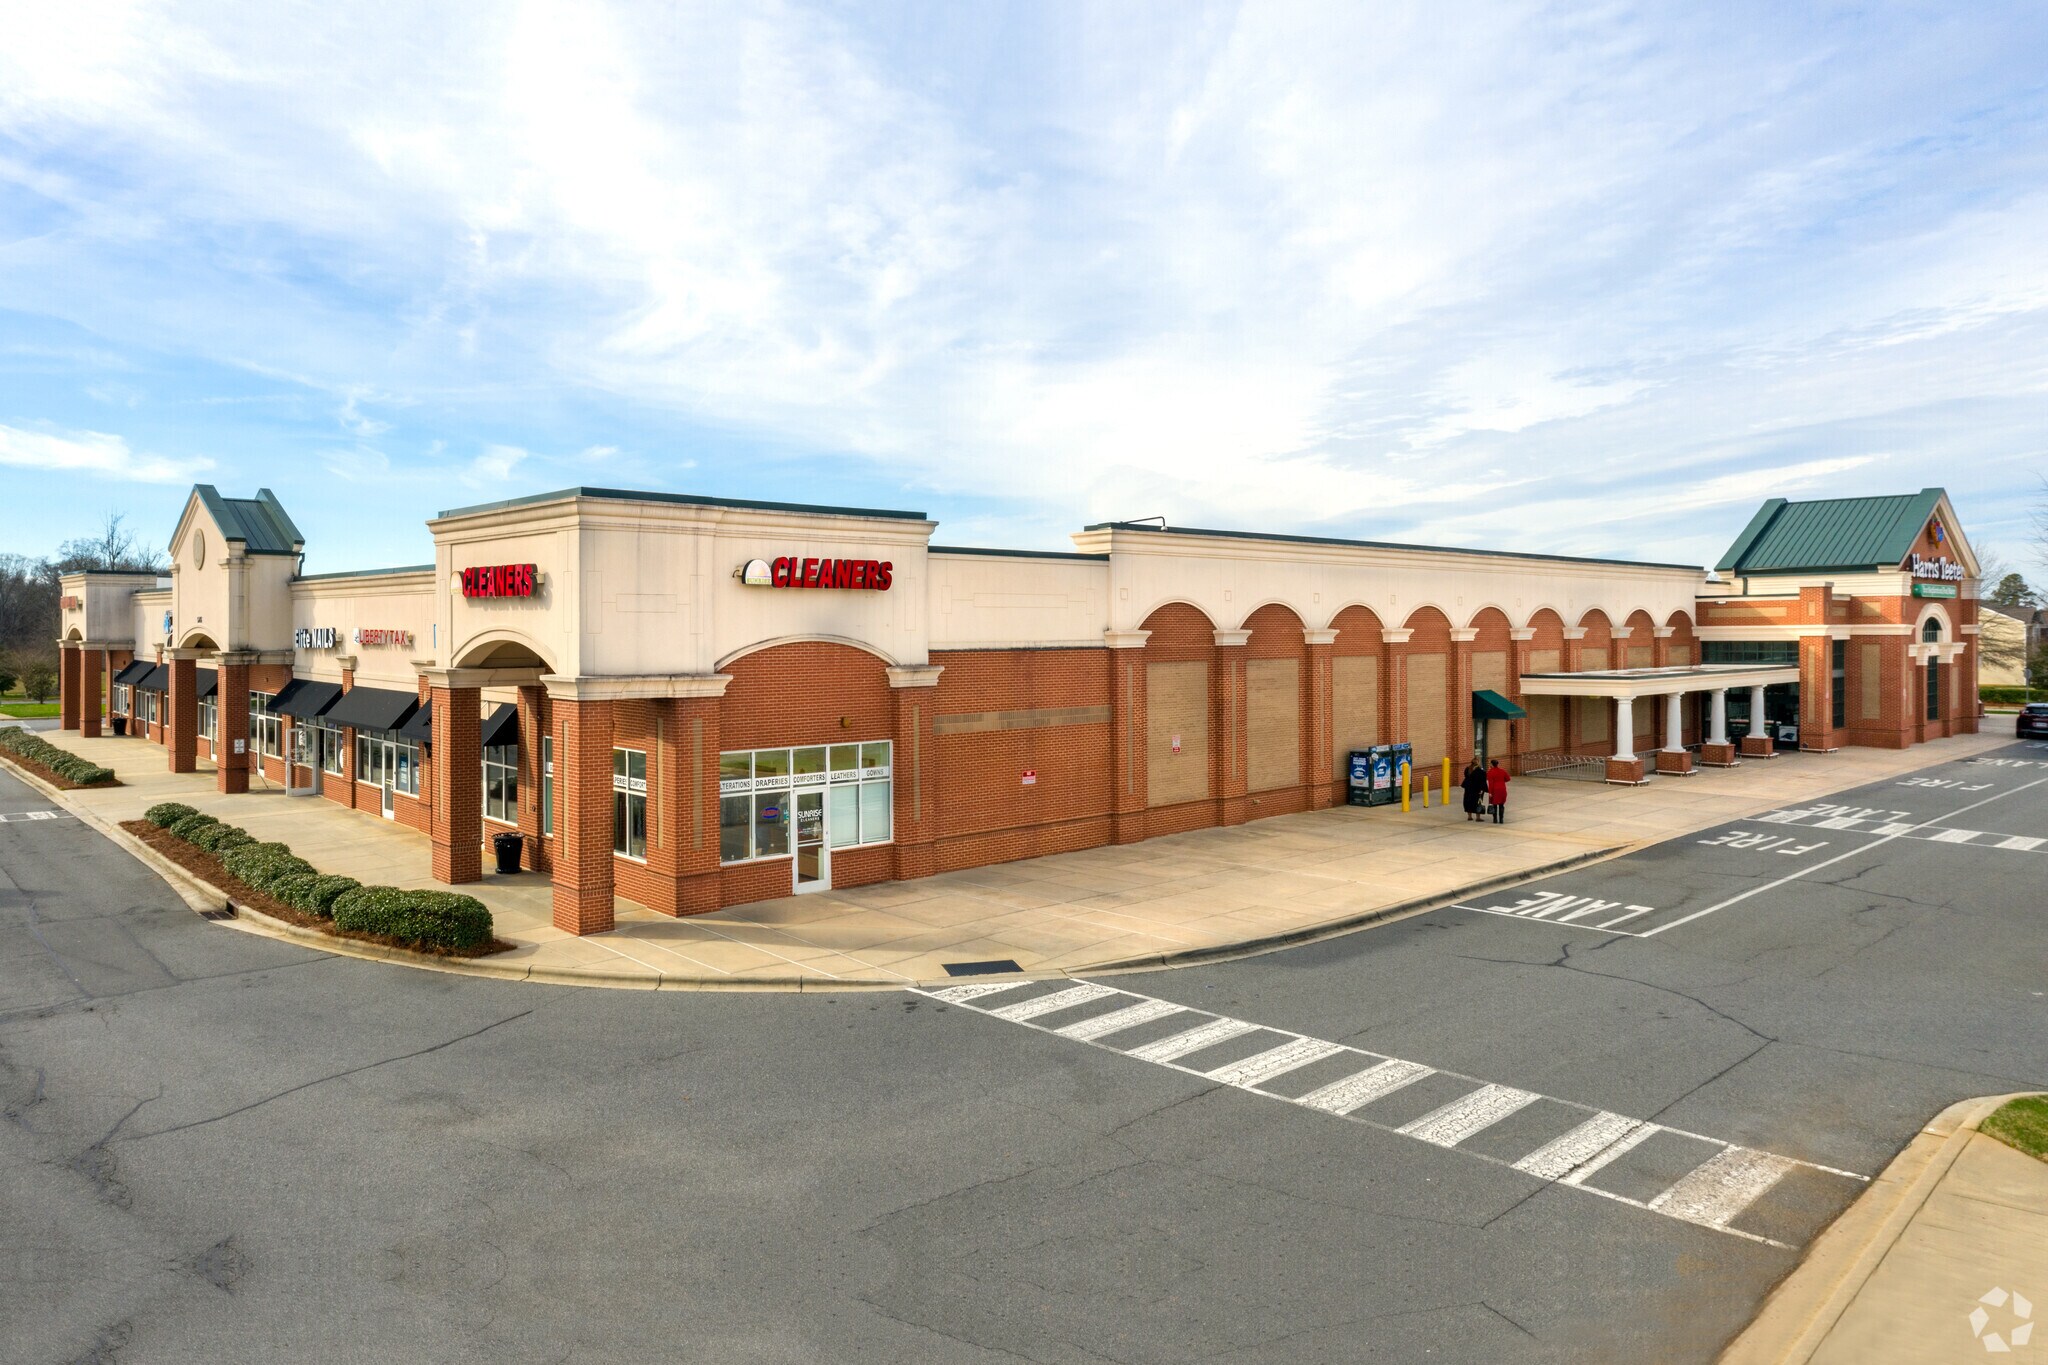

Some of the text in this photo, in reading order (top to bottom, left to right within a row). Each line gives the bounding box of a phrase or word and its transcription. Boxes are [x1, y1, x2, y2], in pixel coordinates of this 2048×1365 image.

[772, 556, 893, 591] CLEANERS
[1912, 553, 1965, 581] Harris Teeter
[463, 563, 533, 598] CLEANERS
[295, 627, 334, 649] Elite NAILS
[359, 629, 407, 645] LIBERTY TAX
[755, 777, 788, 787] DRAPERIES
[793, 773, 826, 783] COMFORTERS
[830, 771, 857, 780] LEATHERS
[866, 768, 884, 777] GOWNS
[1895, 777, 1995, 791] FIRE
[797, 809, 823, 819] SUNRISE
[1805, 803, 1912, 823] LANE
[1696, 830, 1830, 856] FIRE
[1486, 891, 1656, 928] LANE
